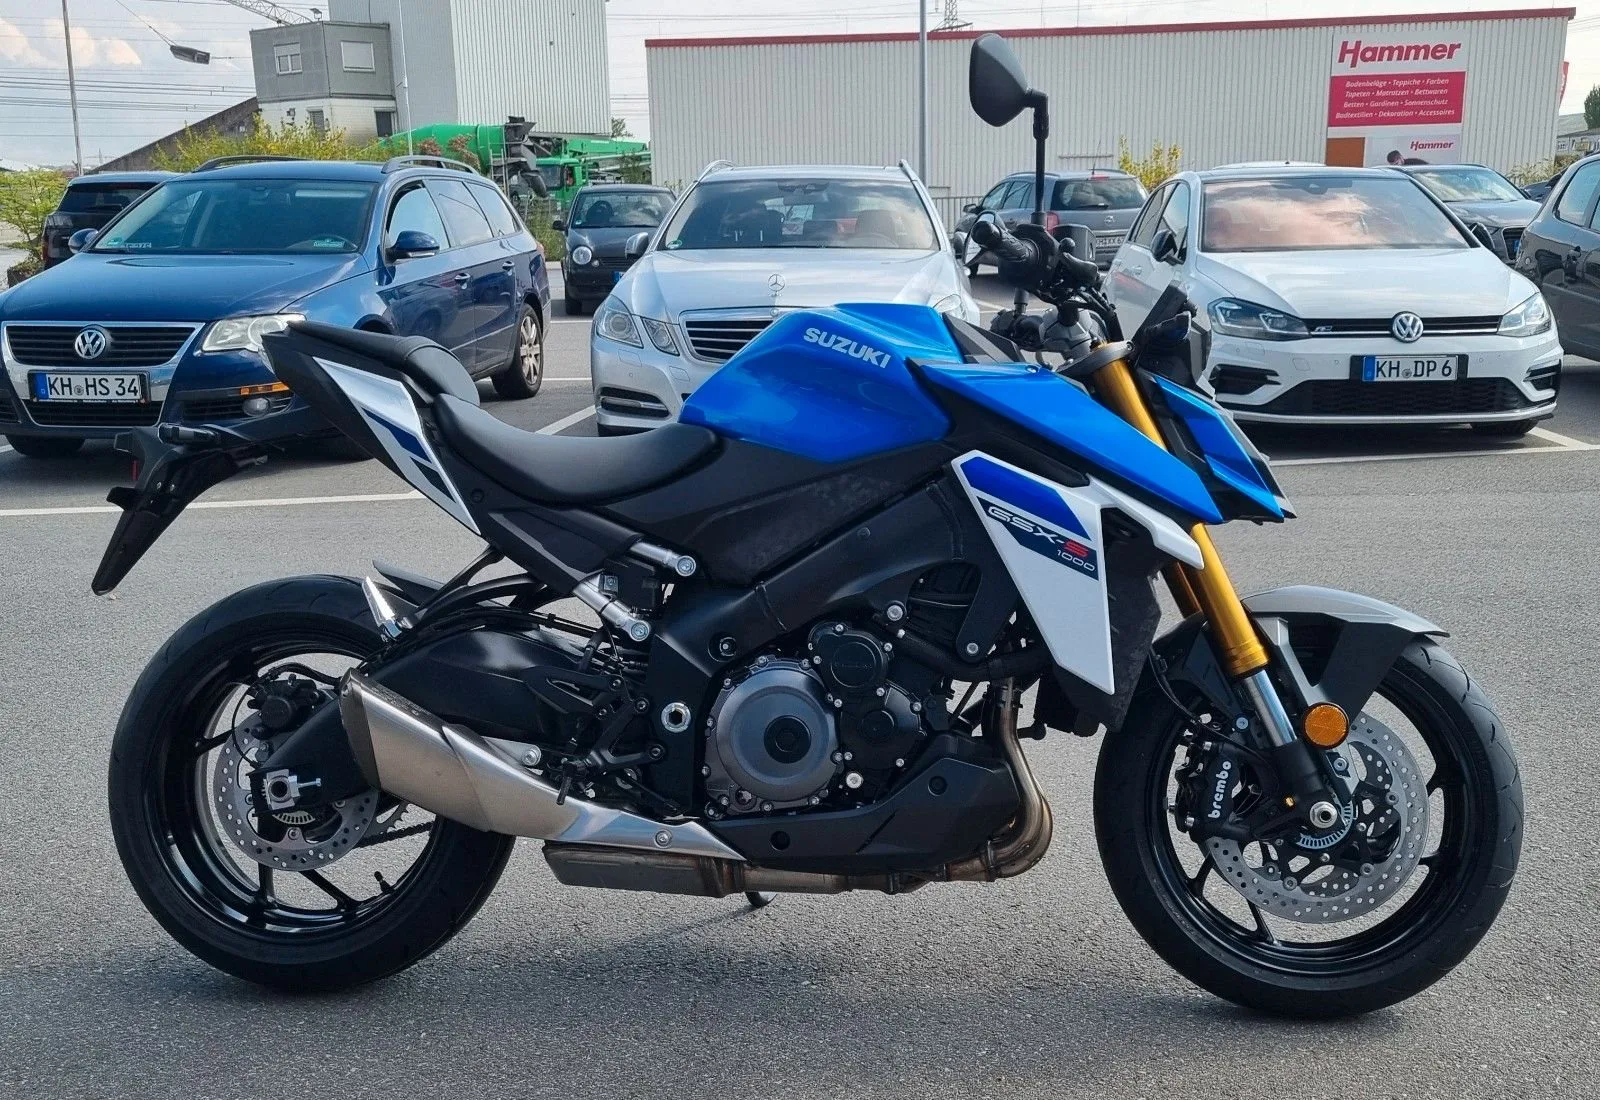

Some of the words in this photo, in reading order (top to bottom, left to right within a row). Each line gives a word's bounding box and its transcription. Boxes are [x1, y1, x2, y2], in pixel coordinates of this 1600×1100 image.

[1337, 40, 1462, 68] Hammer
[1345, 80, 1387, 88] Bodenbeläge
[1392, 78, 1421, 87] Teppiche
[1425, 77, 1449, 85] Farben
[1404, 98, 1448, 106] Sonnenschutz
[1335, 111, 1373, 119] Badtextilien
[1378, 110, 1413, 118] Dekoration
[1410, 141, 1453, 151] Hammer
[803, 327, 891, 369] SUZUKI
[1375, 360, 1400, 378] KH
[1413, 360, 1437, 377] DP
[1441, 359, 1452, 377] 6
[47, 376, 73, 396] KH
[85, 377, 110, 396] HS
[115, 377, 139, 397] 34
[987, 506, 1089, 558] GSX-S
[1057, 549, 1096, 572] 1000
[1207, 760, 1232, 819] brembo
